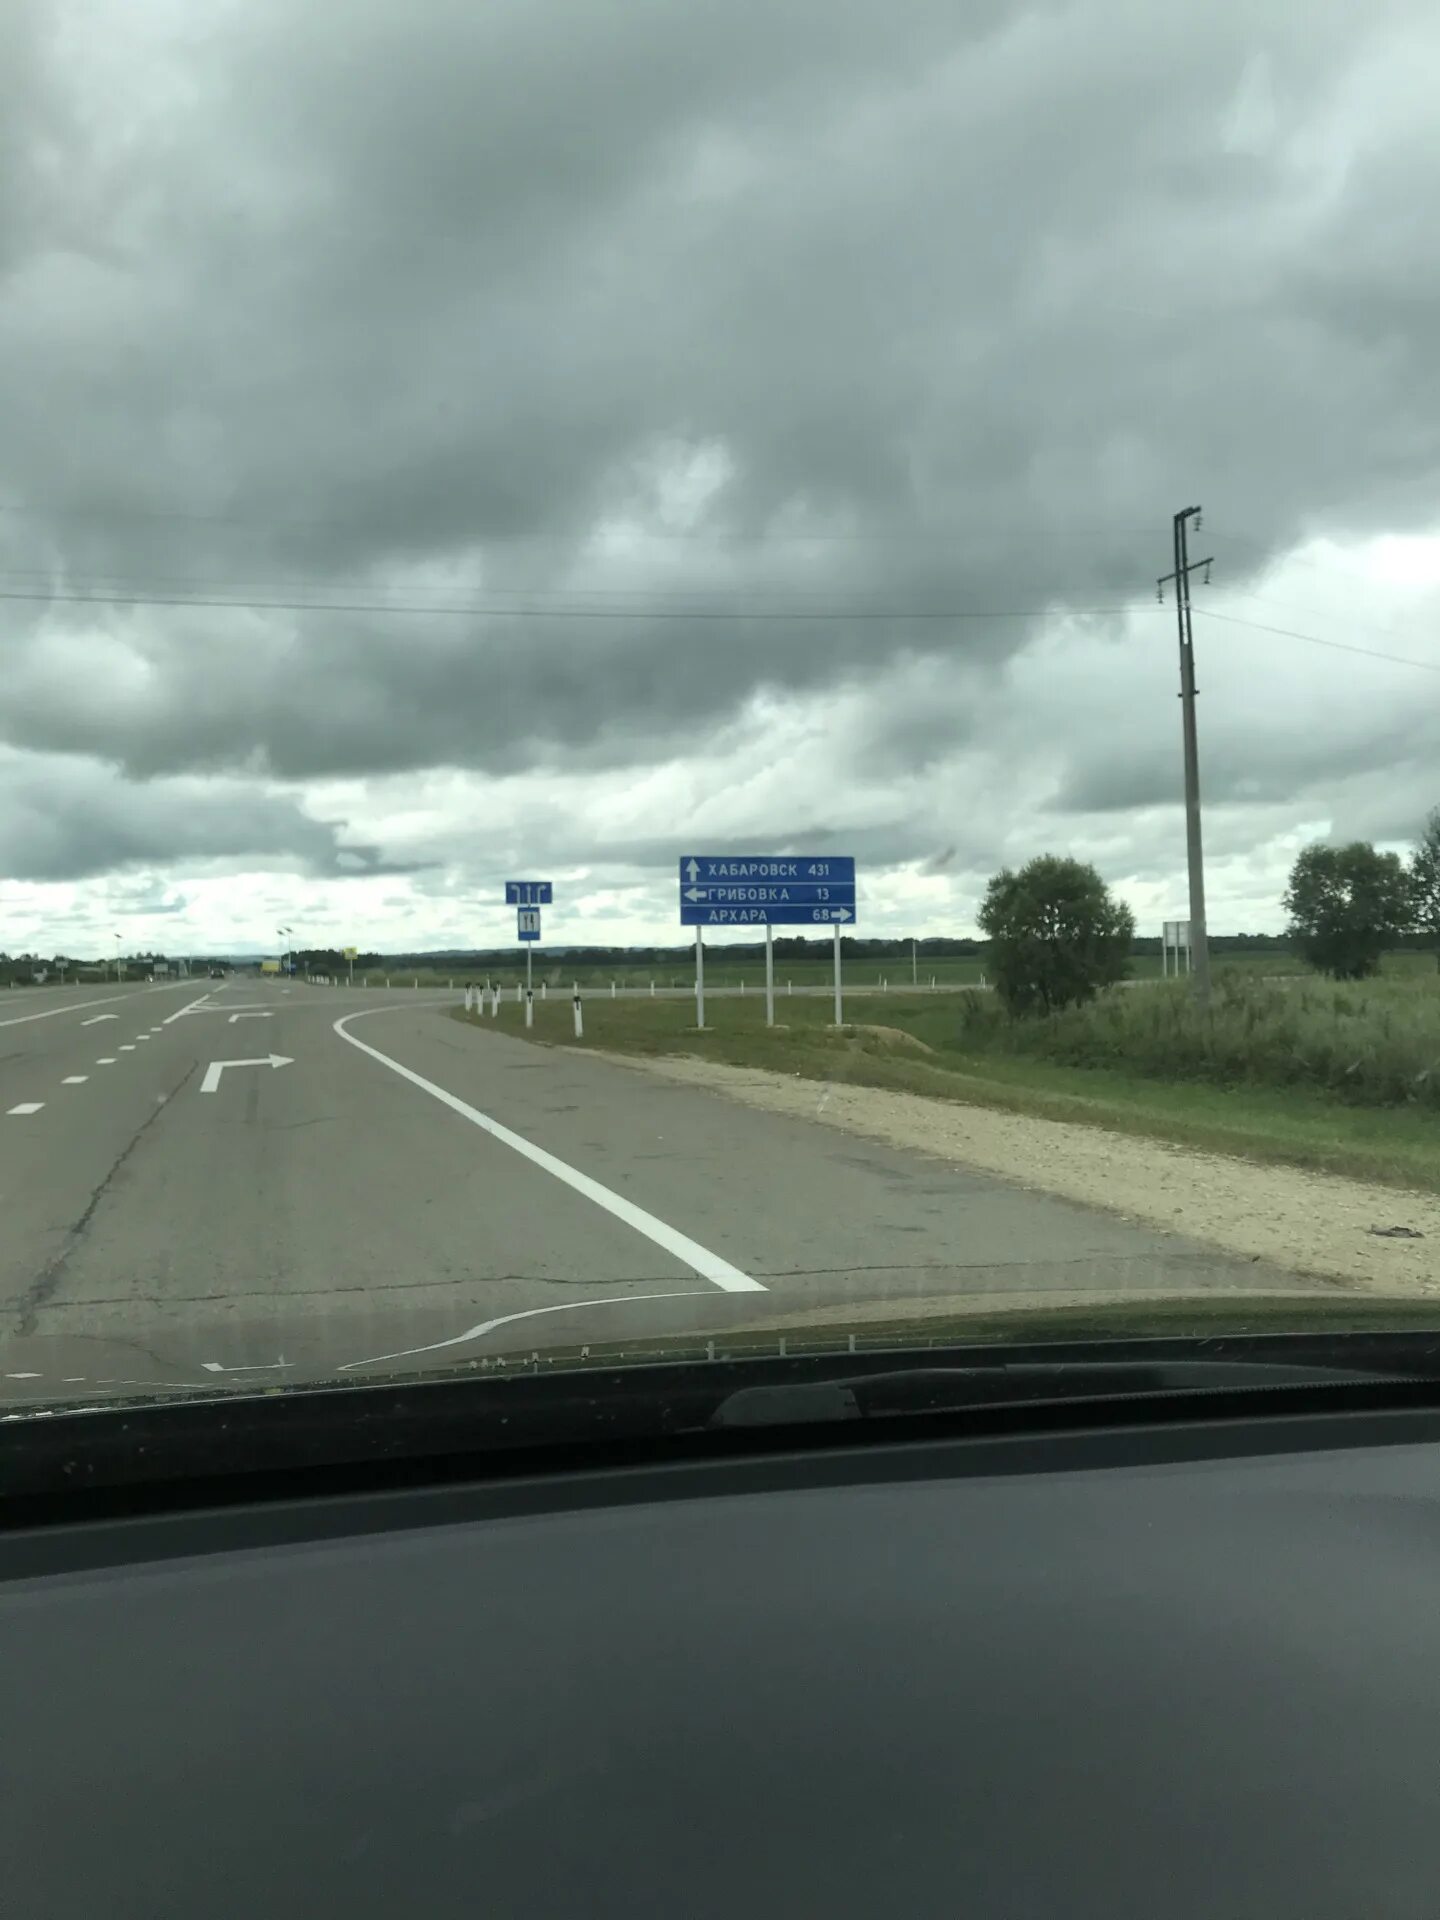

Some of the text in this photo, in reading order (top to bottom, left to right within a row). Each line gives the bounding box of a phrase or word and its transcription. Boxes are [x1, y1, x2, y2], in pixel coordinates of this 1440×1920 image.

[708, 863, 829, 876] ХАБАРОВСК 431
[707, 888, 829, 900] ГРИБОВКА 13
[709, 909, 768, 921] АРХАРА
